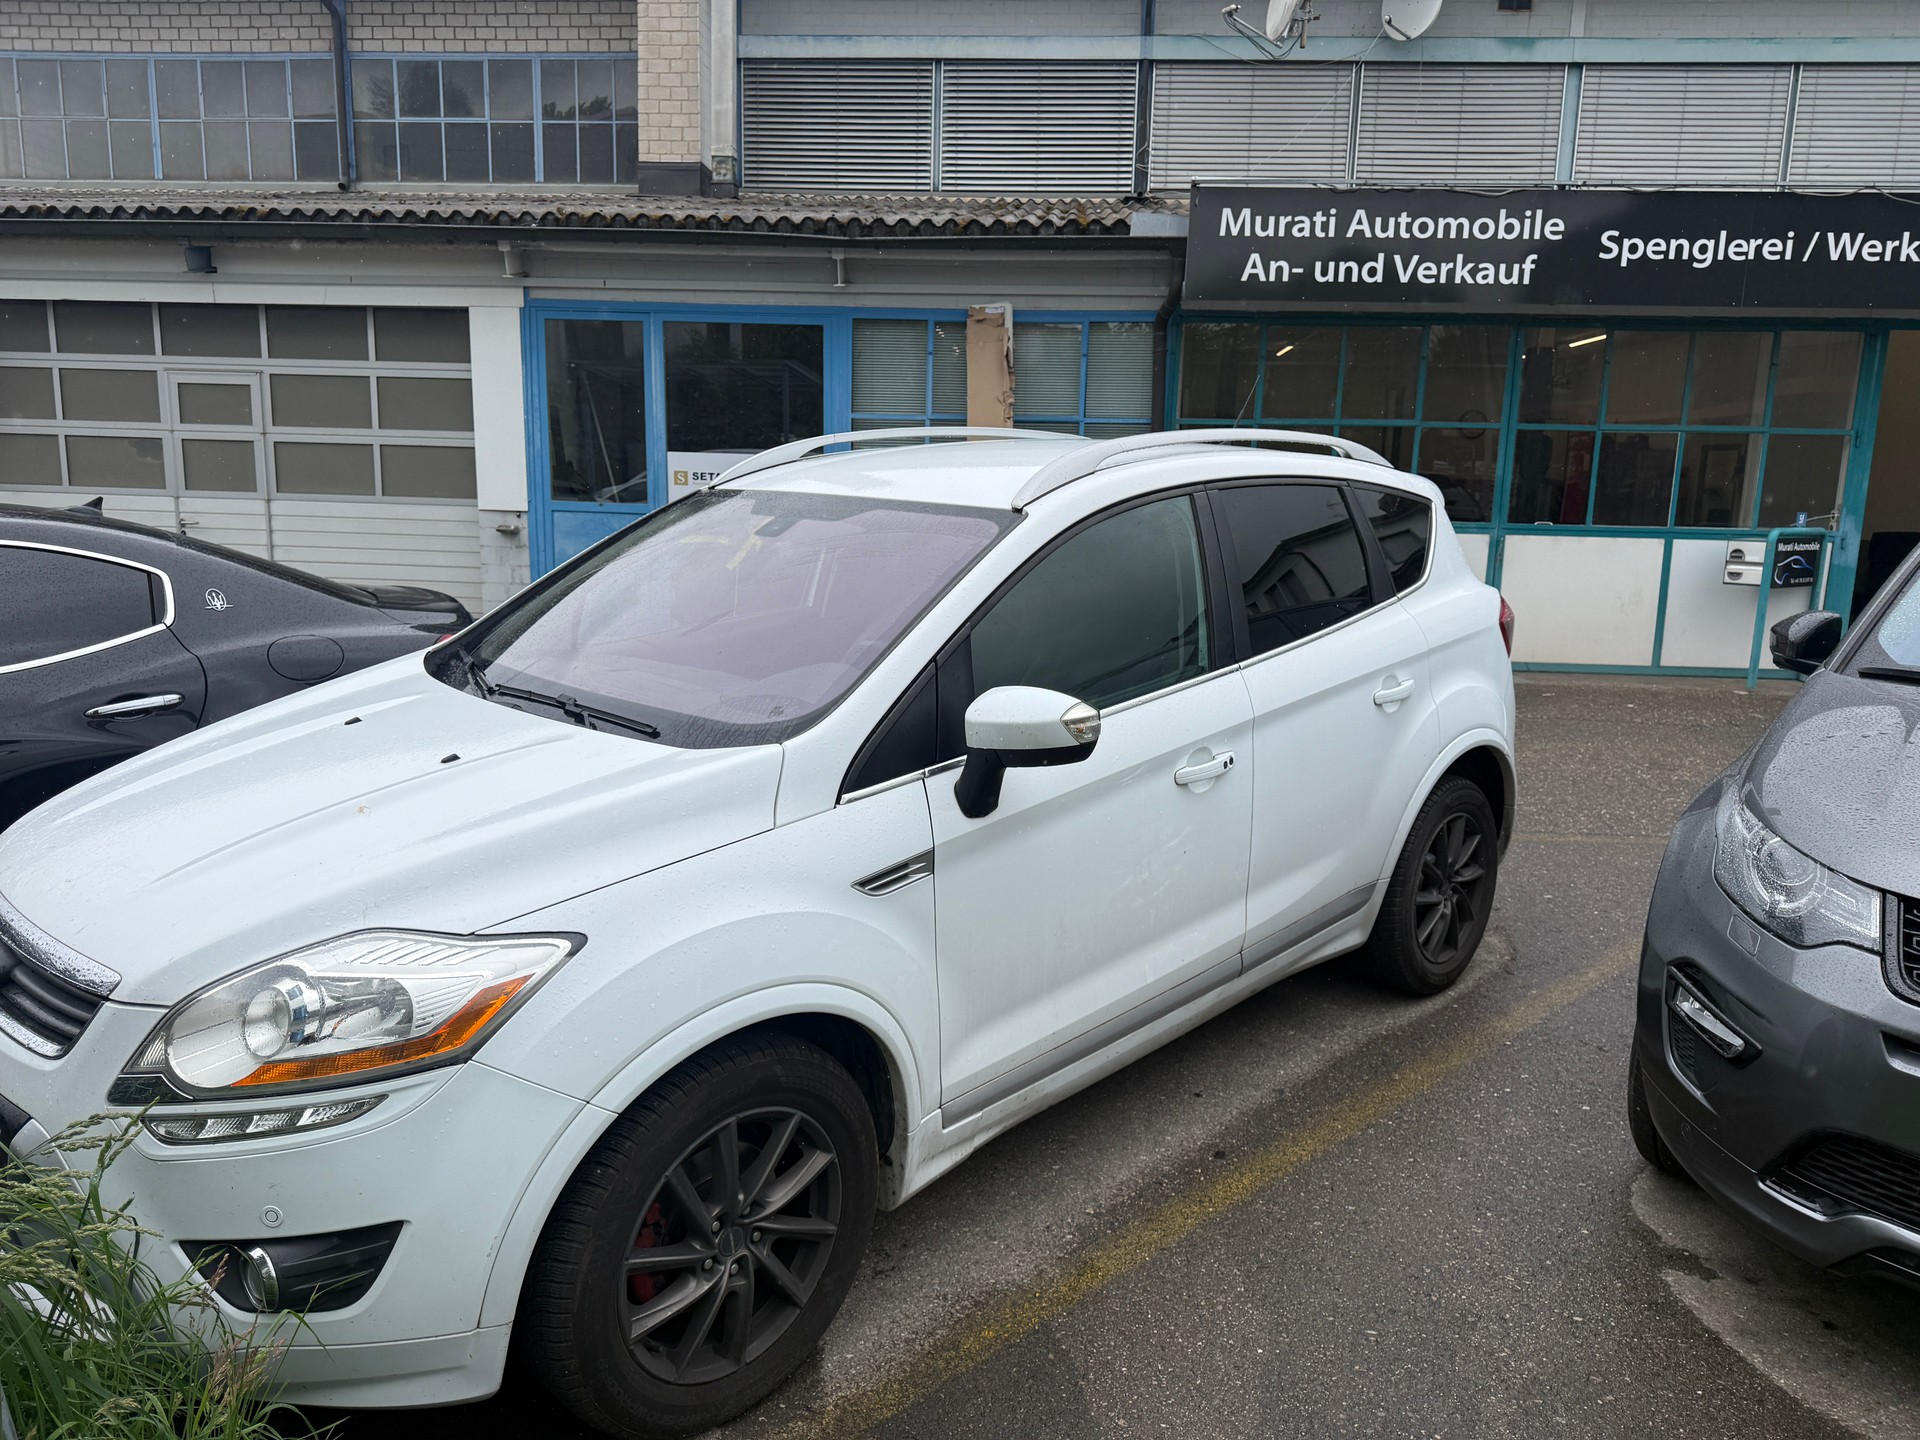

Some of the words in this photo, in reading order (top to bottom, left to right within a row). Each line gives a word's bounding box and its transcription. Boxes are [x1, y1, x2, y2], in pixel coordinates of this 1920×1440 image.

[1218, 207, 1337, 239] Murati
[1345, 208, 1565, 241] Automobile
[1598, 229, 1795, 269] Spenglerei
[1801, 231, 1821, 262] /
[1827, 231, 1920, 262] Werk
[1240, 252, 1304, 283] An-
[1314, 252, 1385, 284] und
[1393, 253, 1538, 285] Verkauf
[1778, 542, 1793, 551] Murati
[1794, 541, 1820, 551] Automobile
